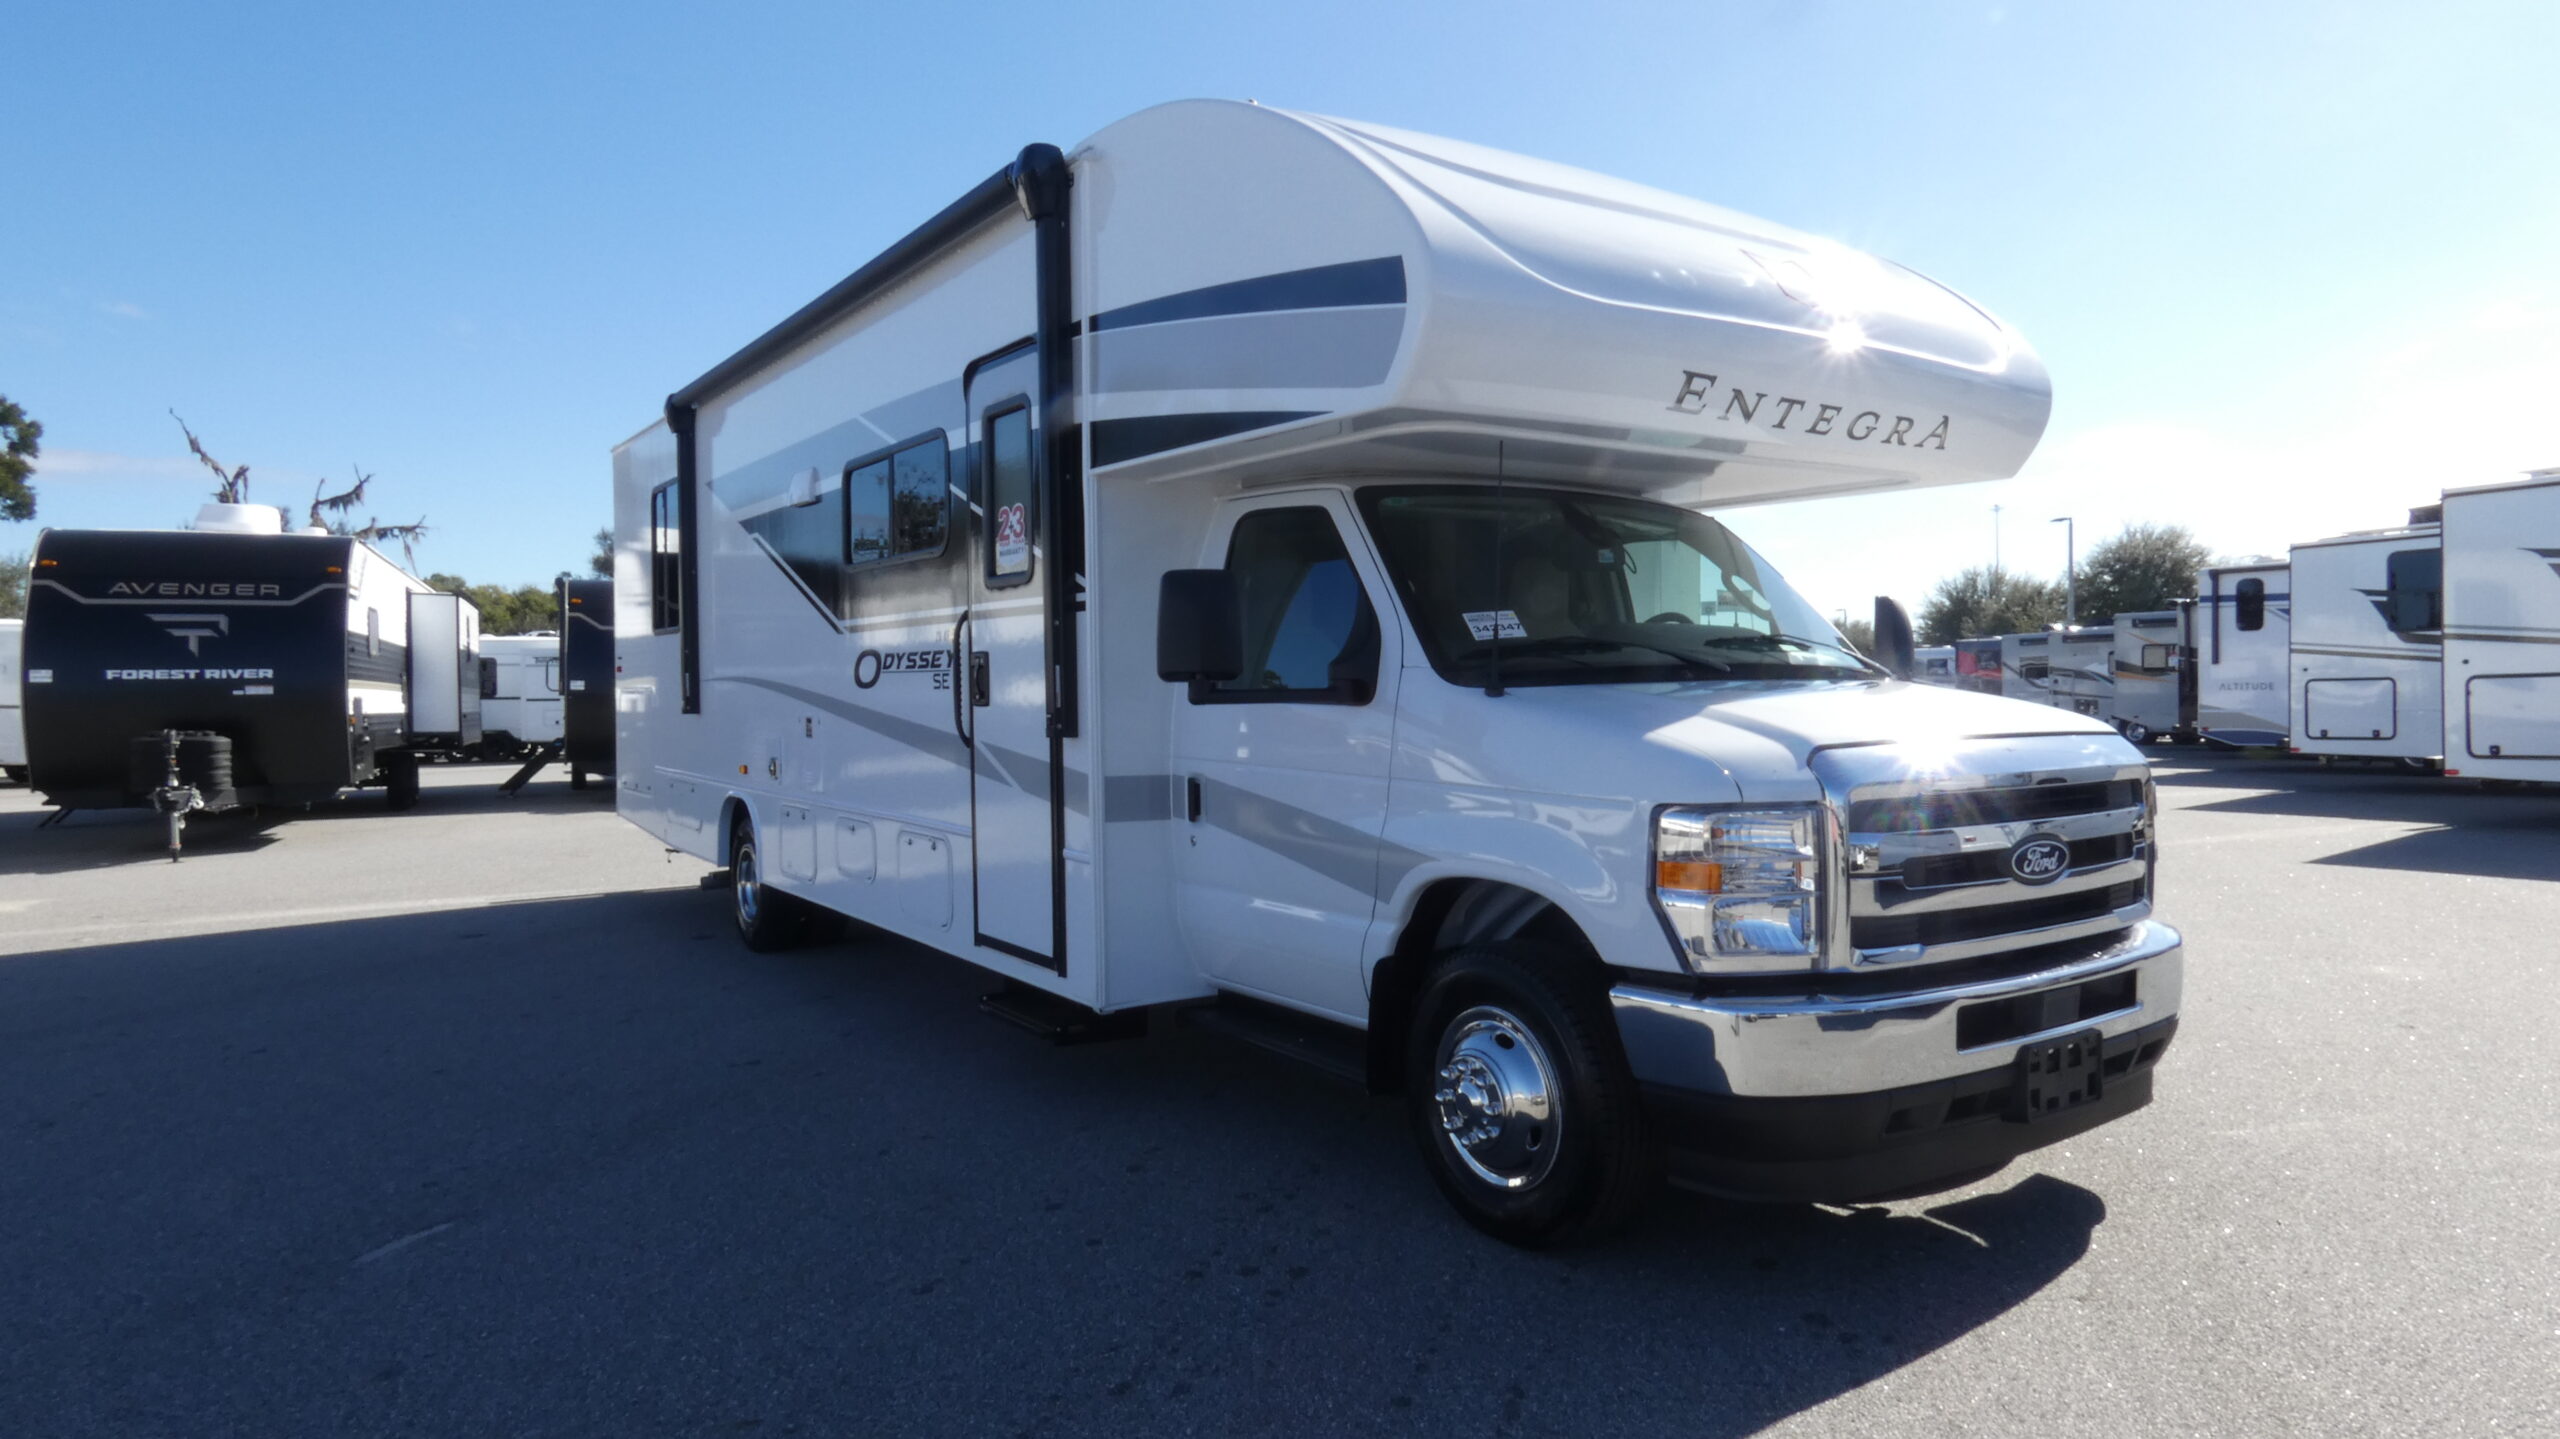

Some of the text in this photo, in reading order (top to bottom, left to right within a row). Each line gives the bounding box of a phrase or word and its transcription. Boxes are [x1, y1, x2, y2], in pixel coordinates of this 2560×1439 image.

[1665, 369, 1950, 451] ENTEGRA
[108, 582, 280, 596] AVENGER
[105, 668, 274, 680] FOREST RIVER
[854, 649, 955, 689] ODYSSEY
[933, 673, 950, 689] SE
[2219, 682, 2274, 691] ALTITUDE
[2023, 846, 2059, 873] Ford
